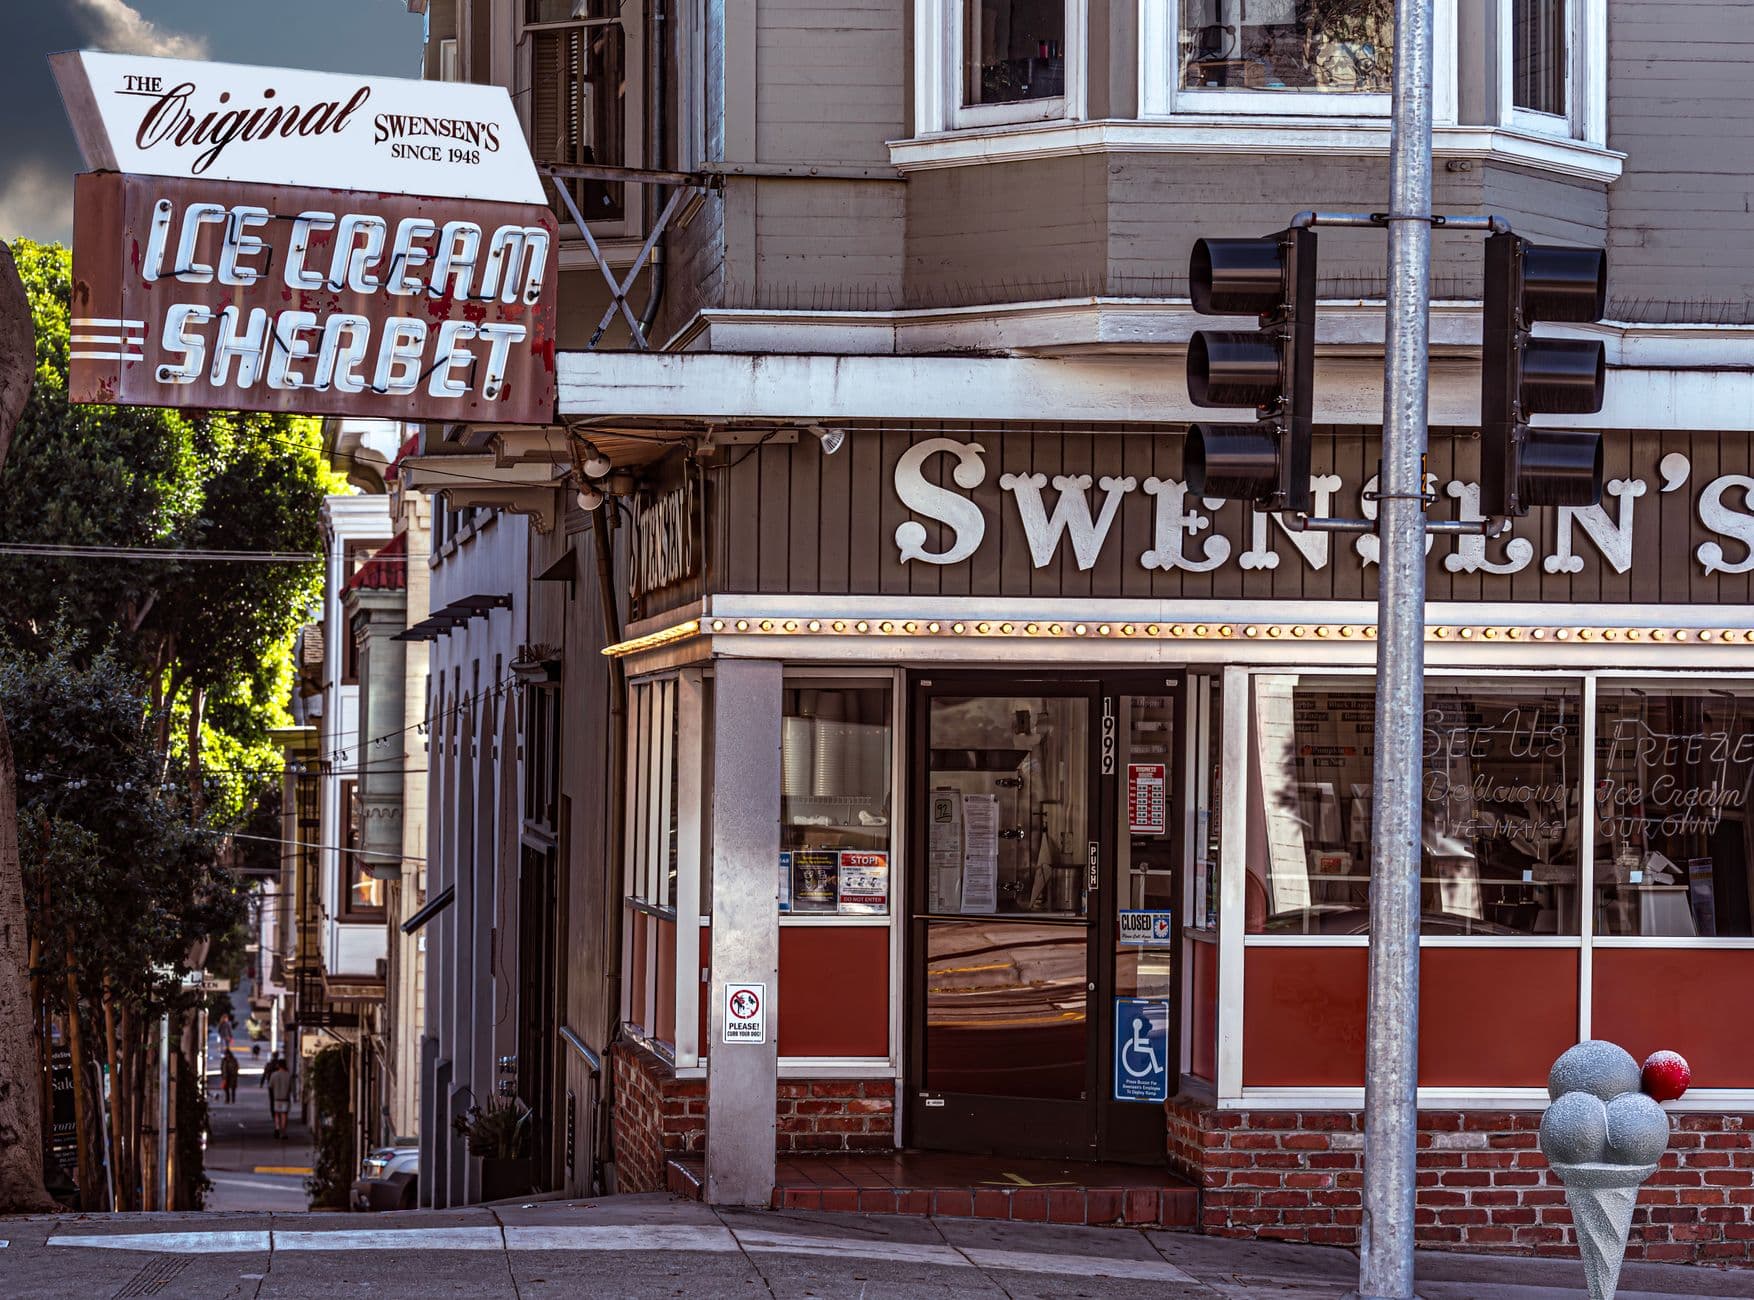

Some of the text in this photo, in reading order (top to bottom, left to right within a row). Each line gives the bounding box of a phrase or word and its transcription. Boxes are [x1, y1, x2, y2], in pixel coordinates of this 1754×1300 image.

[124, 75, 163, 92] THE
[135, 82, 371, 175] Original
[374, 113, 500, 152] SWENSEN'S
[391, 143, 480, 165] SINCE 1948
[143, 199, 550, 305] ICE CREAM
[155, 303, 527, 400] SHERBET
[1104, 698, 1113, 773] 1999
[1651, 774, 1744, 807] Cream
[850, 856, 879, 865] STOP!
[1121, 914, 1152, 931] CLOSED
[729, 1022, 759, 1030] PLEASE!
